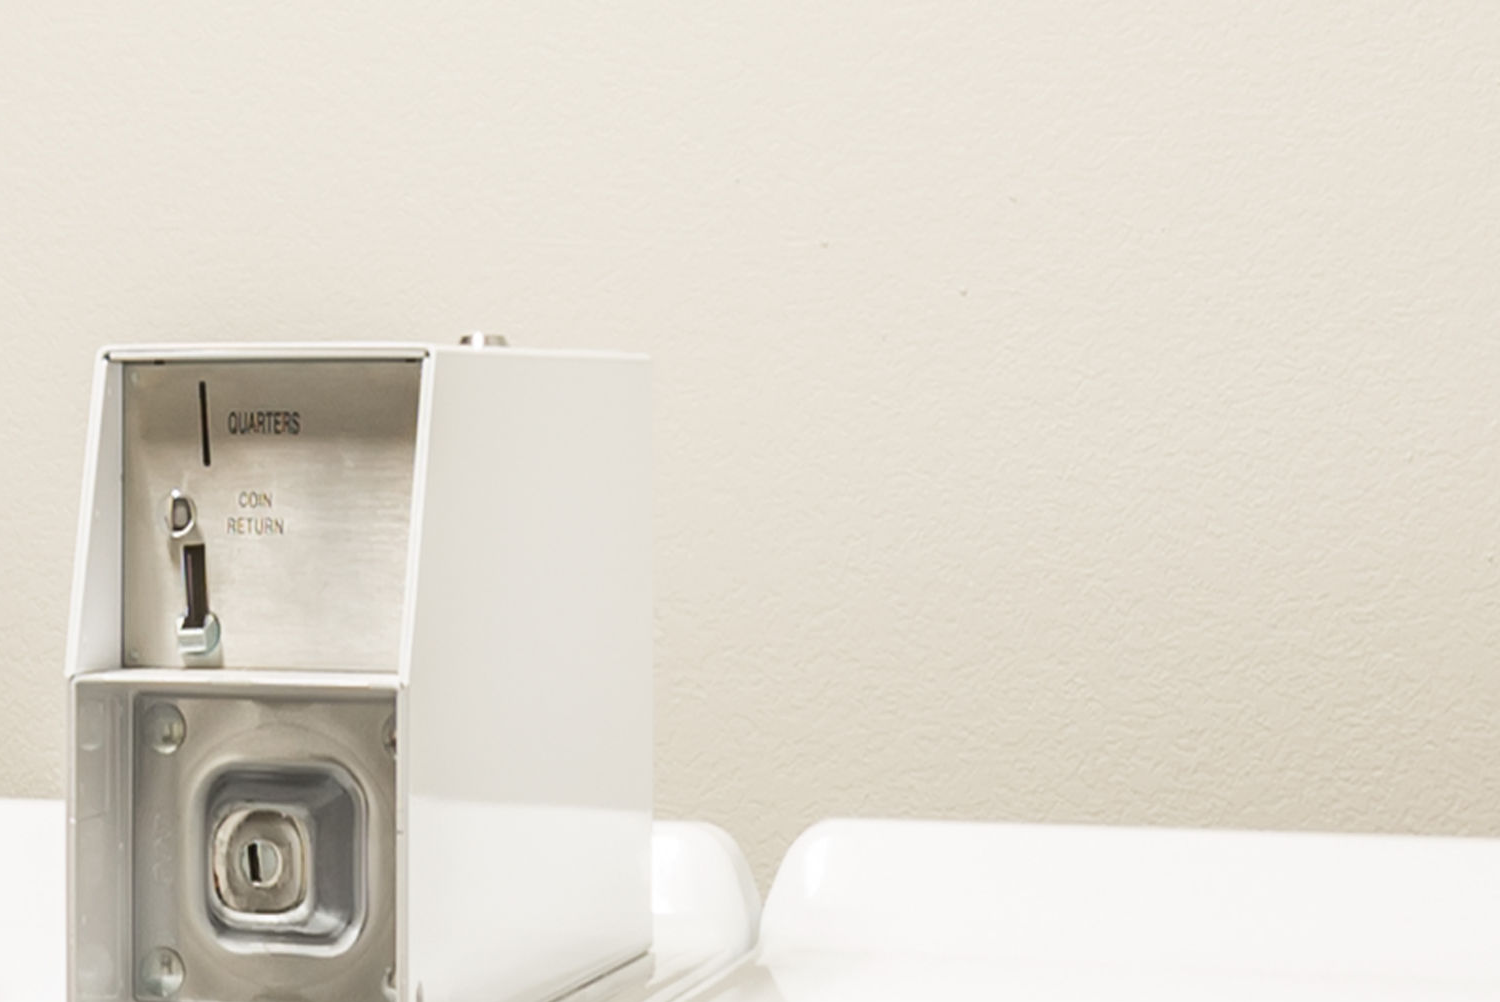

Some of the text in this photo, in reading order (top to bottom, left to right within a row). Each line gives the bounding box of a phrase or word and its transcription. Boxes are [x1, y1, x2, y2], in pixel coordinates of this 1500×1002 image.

[227, 411, 300, 435] QUARTERS
[238, 492, 272, 508] COIN
[227, 517, 284, 535] RETURN
